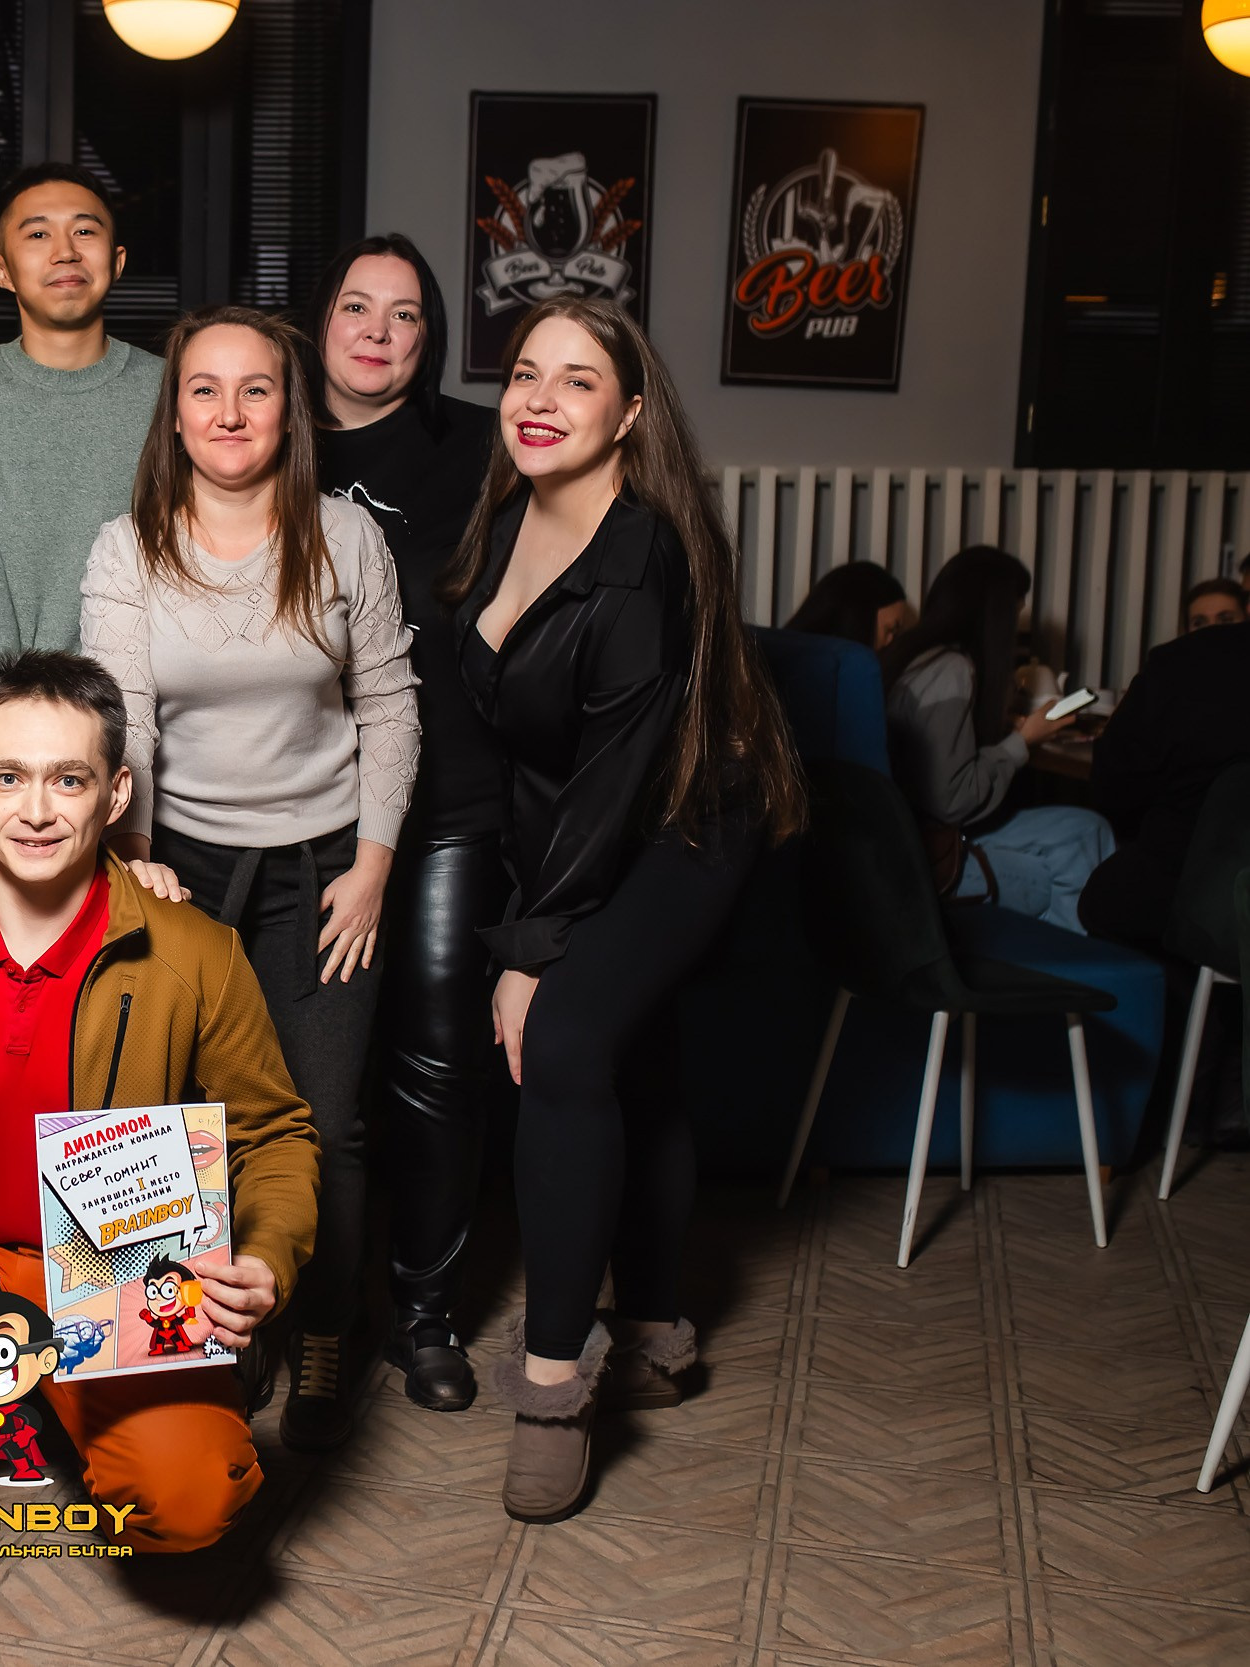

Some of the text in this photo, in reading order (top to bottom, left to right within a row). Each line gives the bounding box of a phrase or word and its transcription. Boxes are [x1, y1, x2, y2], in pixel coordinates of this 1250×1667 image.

[737, 248, 888, 333] Beer
[805, 315, 858, 339] PUB
[55, 1125, 173, 1172] НАГРАЖДАЕТСЯ КОМАНДА
[63, 1114, 152, 1159] ДИПЛОМОМ
[81, 1171, 181, 1210] ЗАНЯВШАЯ I МЕСТО
[101, 1185, 172, 1215] В СОСТЯЗАНИИ
[99, 1194, 195, 1247] BRAINBOY
